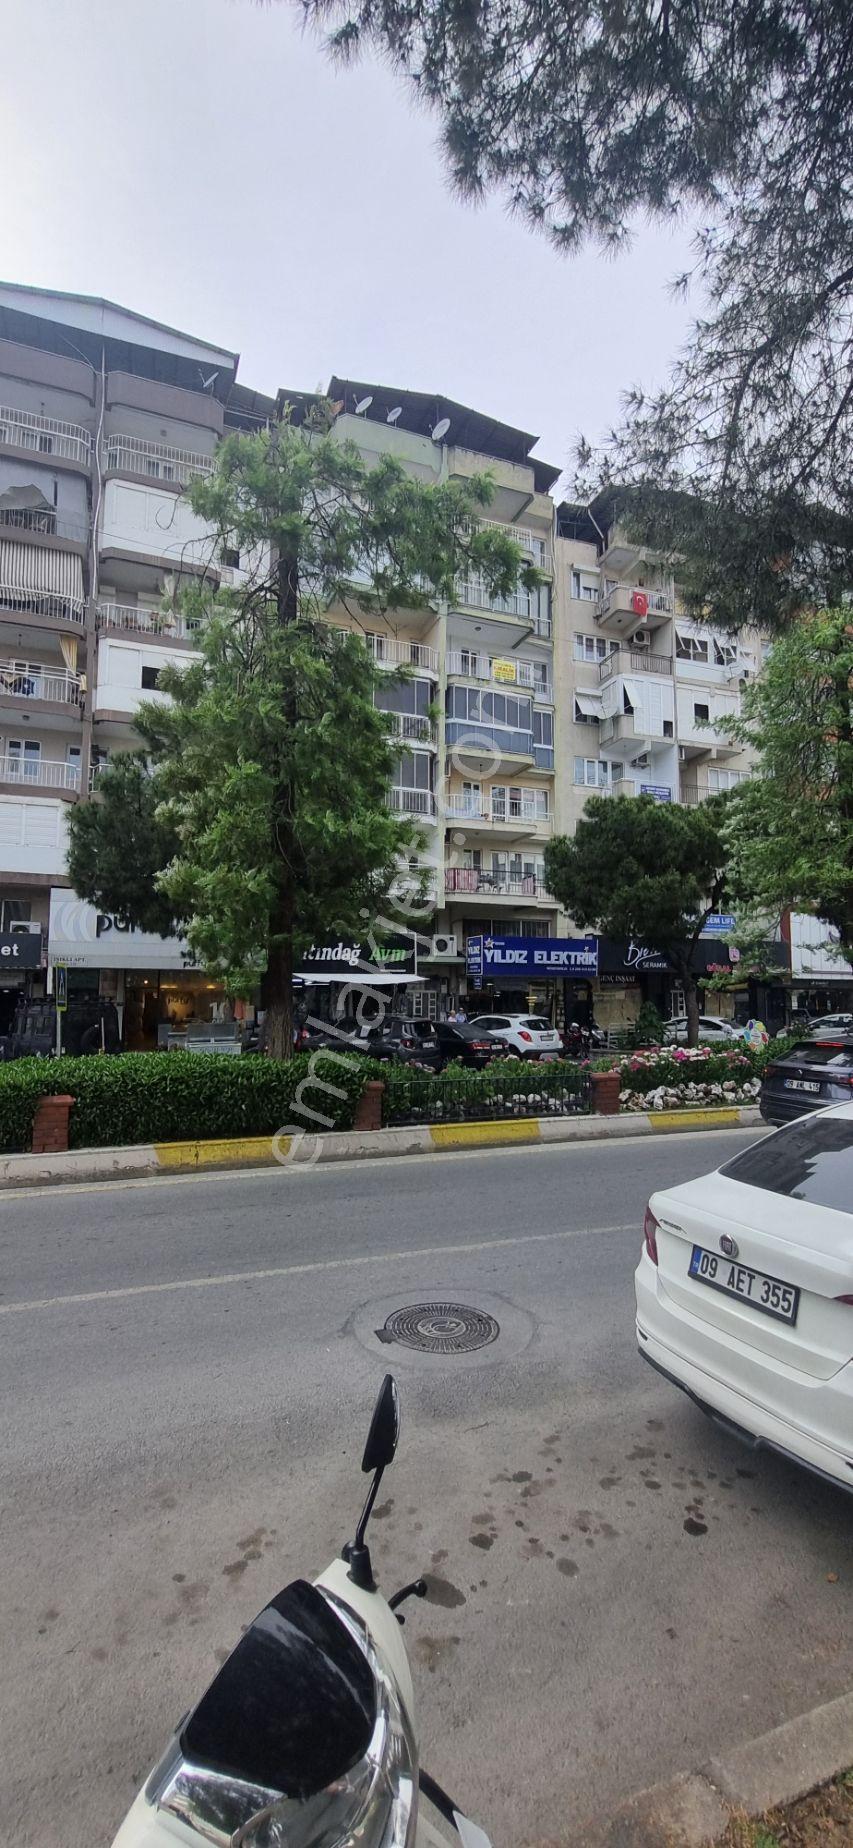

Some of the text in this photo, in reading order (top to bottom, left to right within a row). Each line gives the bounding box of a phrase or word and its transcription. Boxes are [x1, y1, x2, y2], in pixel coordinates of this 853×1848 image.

[484, 949, 528, 963] YILDIZ
[700, 1254, 793, 1314] 09 AET 355
